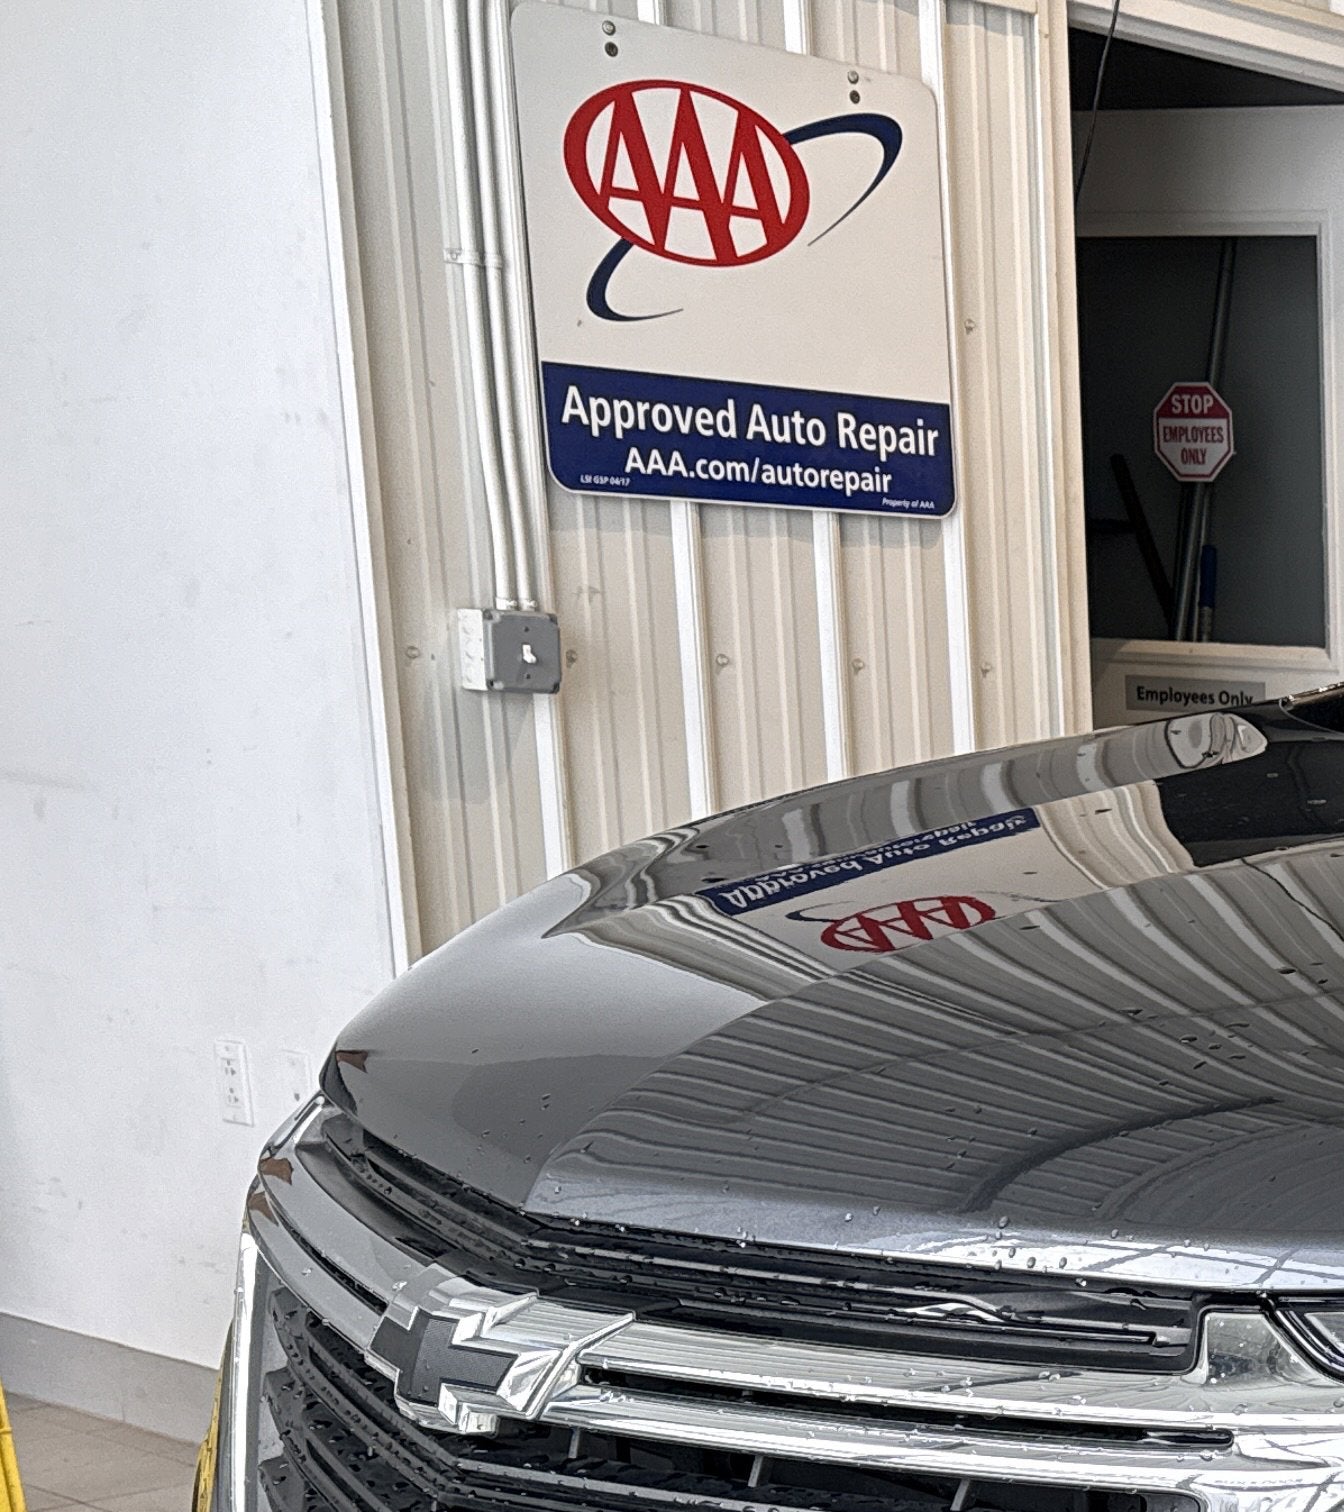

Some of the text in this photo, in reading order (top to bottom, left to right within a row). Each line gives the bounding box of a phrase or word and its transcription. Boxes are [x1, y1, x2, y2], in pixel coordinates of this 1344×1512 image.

[602, 90, 785, 258] AAA
[1171, 394, 1214, 415] STOP
[561, 384, 940, 462] Approved Auto Repair
[1162, 425, 1225, 444] EMPLOYEES
[1180, 447, 1208, 466] ONLY
[625, 446, 893, 496] AAA.com/autorepair
[1136, 685, 1215, 707] Employees
